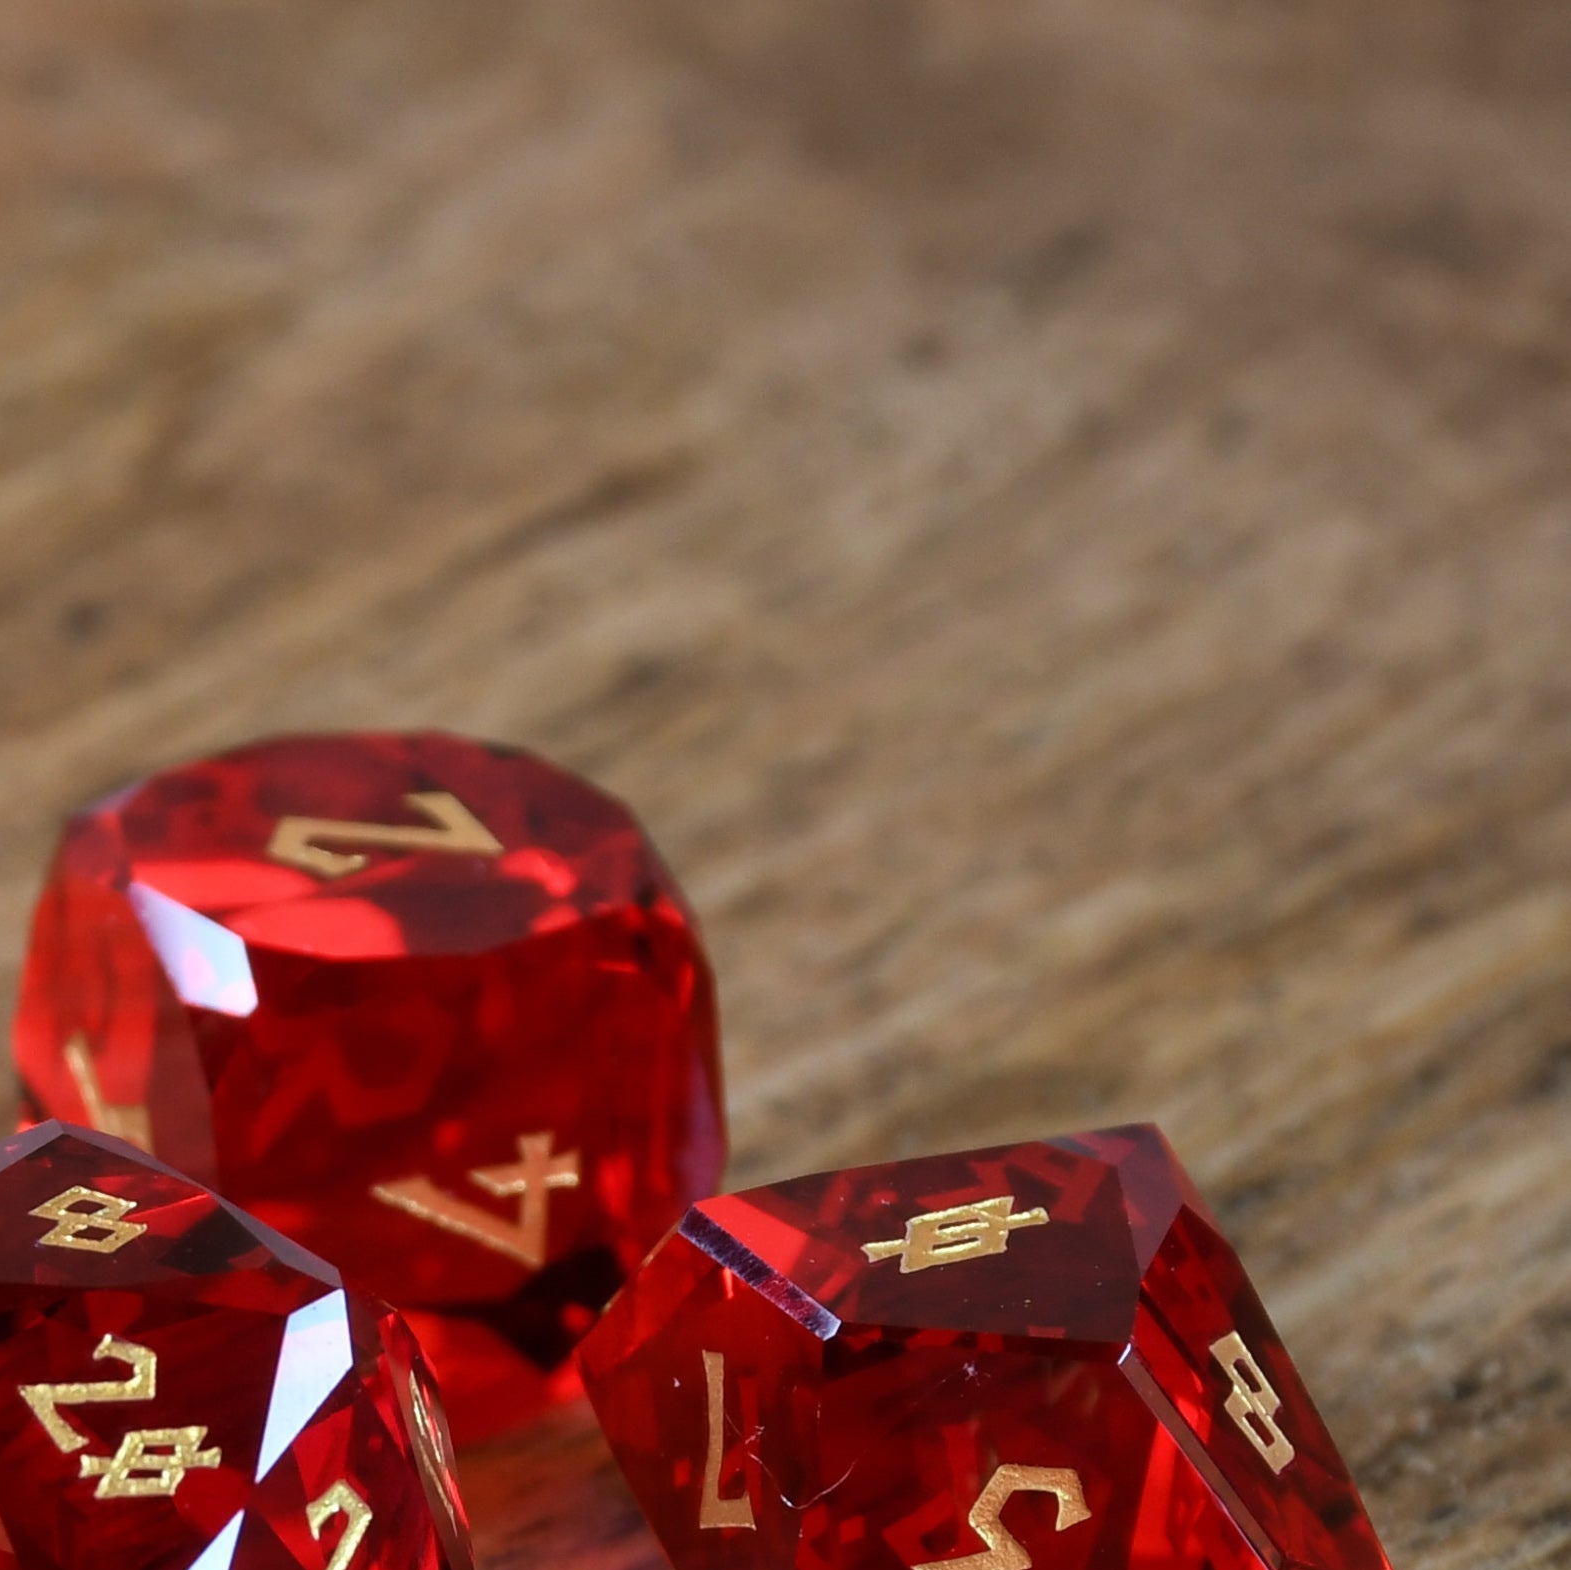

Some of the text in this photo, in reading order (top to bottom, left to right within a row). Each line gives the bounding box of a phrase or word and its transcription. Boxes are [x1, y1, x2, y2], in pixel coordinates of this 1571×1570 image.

[268, 792, 501, 879] 2
[33, 1186, 146, 1253] 8
[376, 1135, 579, 1264] 4
[21, 1337, 221, 1498] 20
[1209, 1331, 1295, 1474] 8
